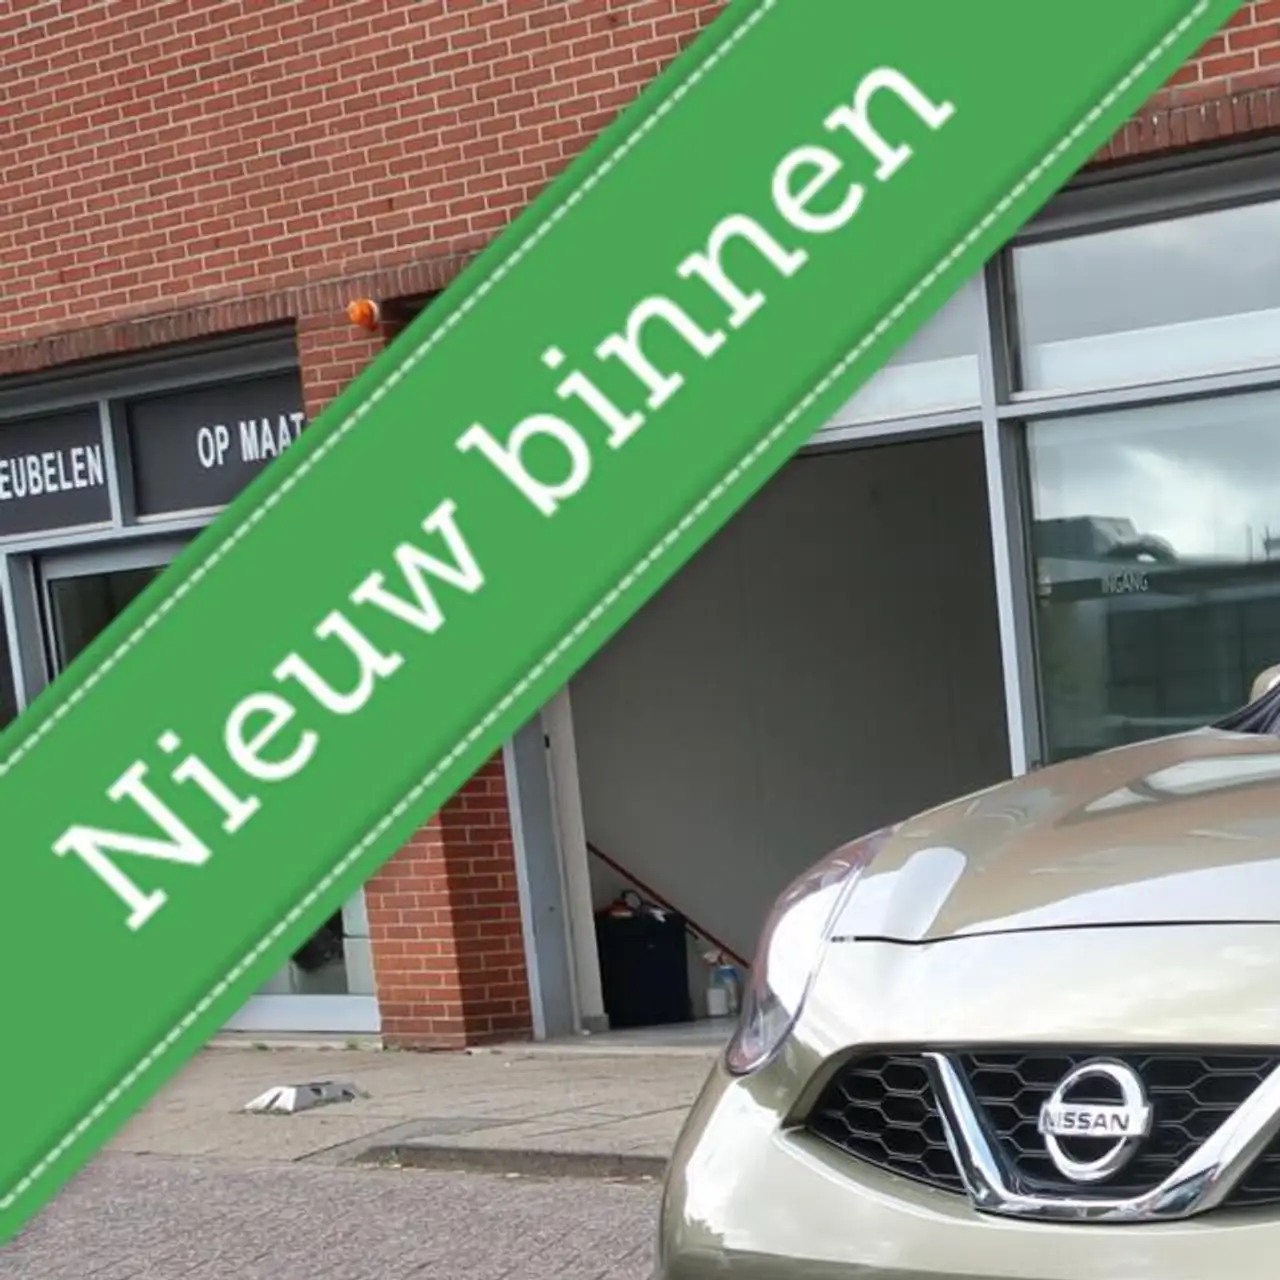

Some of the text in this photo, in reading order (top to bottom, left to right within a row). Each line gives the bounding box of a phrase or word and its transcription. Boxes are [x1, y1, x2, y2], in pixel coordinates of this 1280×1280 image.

[197, 425, 230, 469] OP
[239, 411, 305, 463] MAAT
[1042, 1107, 1131, 1133] NISSAN
